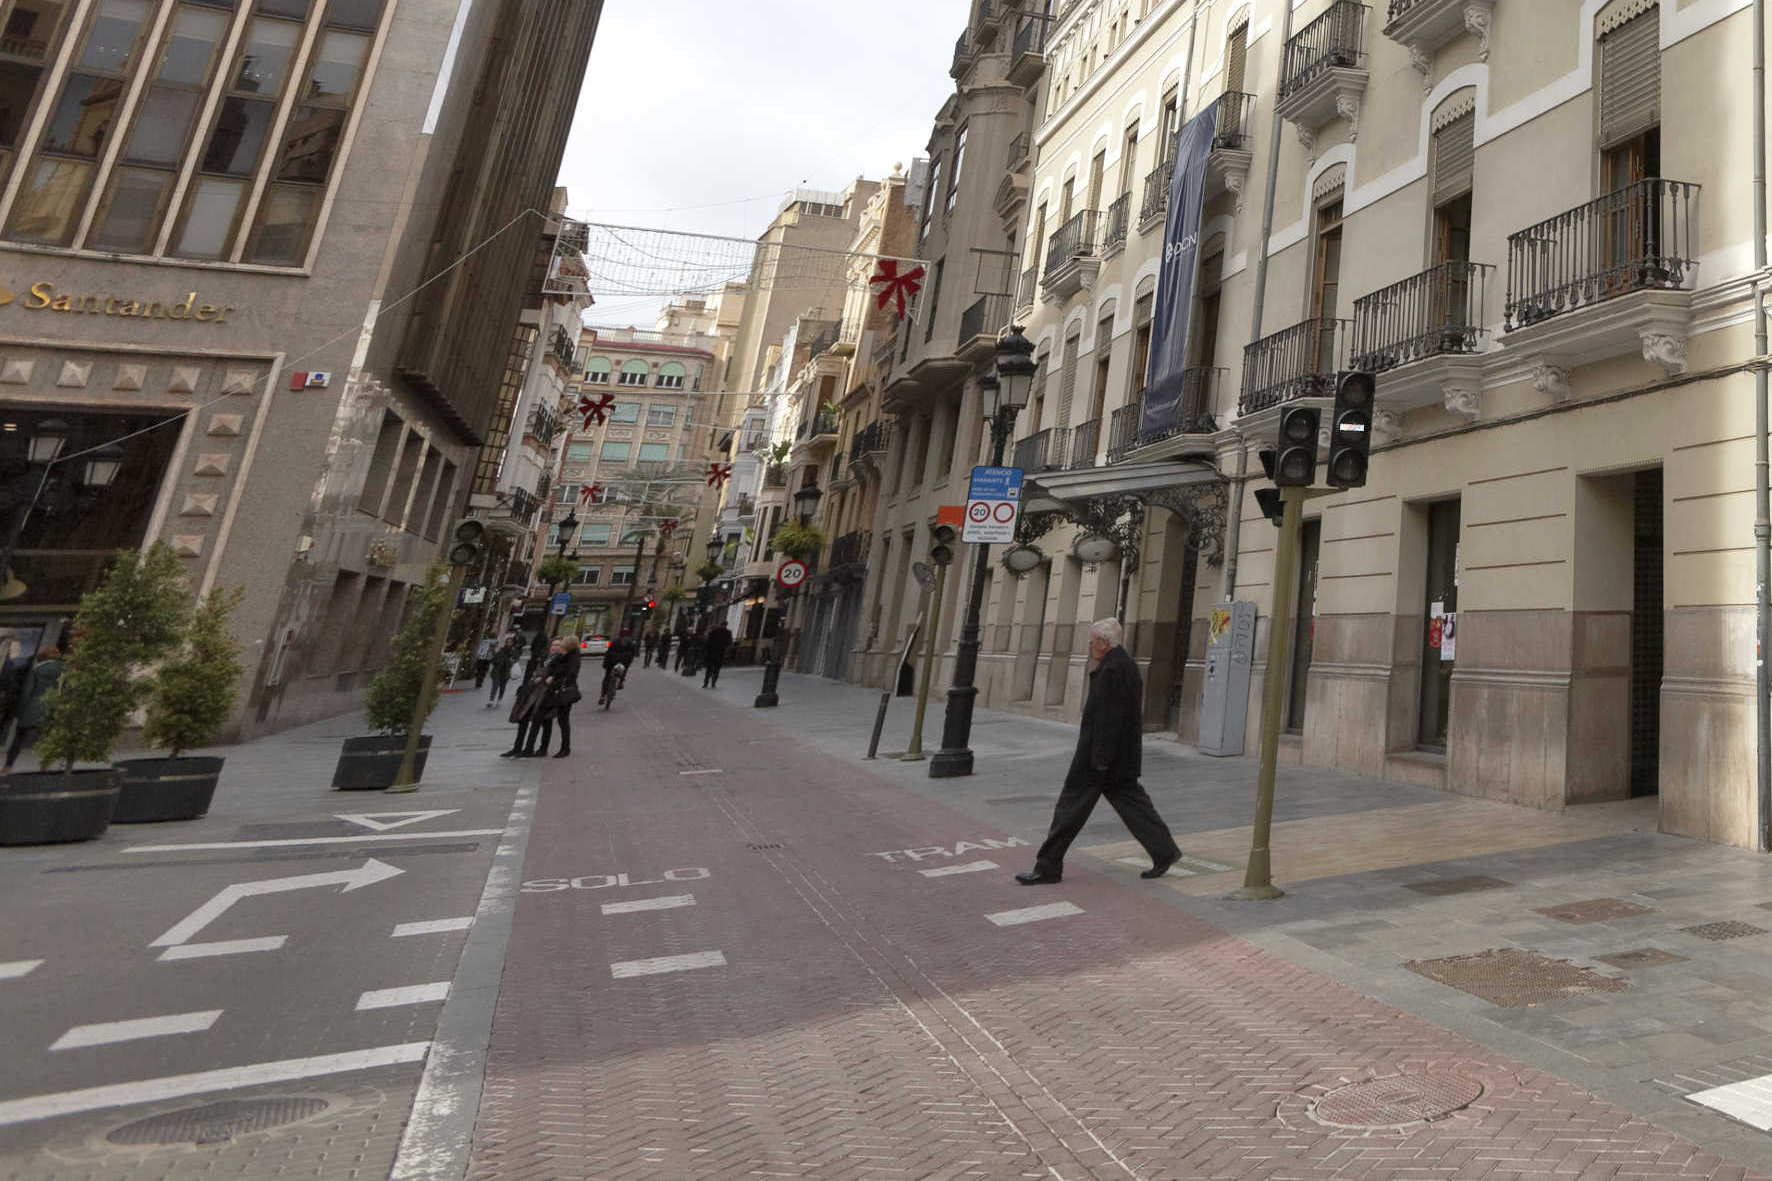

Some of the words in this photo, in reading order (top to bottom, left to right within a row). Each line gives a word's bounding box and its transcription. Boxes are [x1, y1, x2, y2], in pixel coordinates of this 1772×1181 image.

[24, 282, 235, 323] Santander
[973, 507, 986, 517] 20
[783, 569, 802, 579] 20
[863, 835, 1032, 861] TRAM
[520, 868, 711, 893] SOLO
